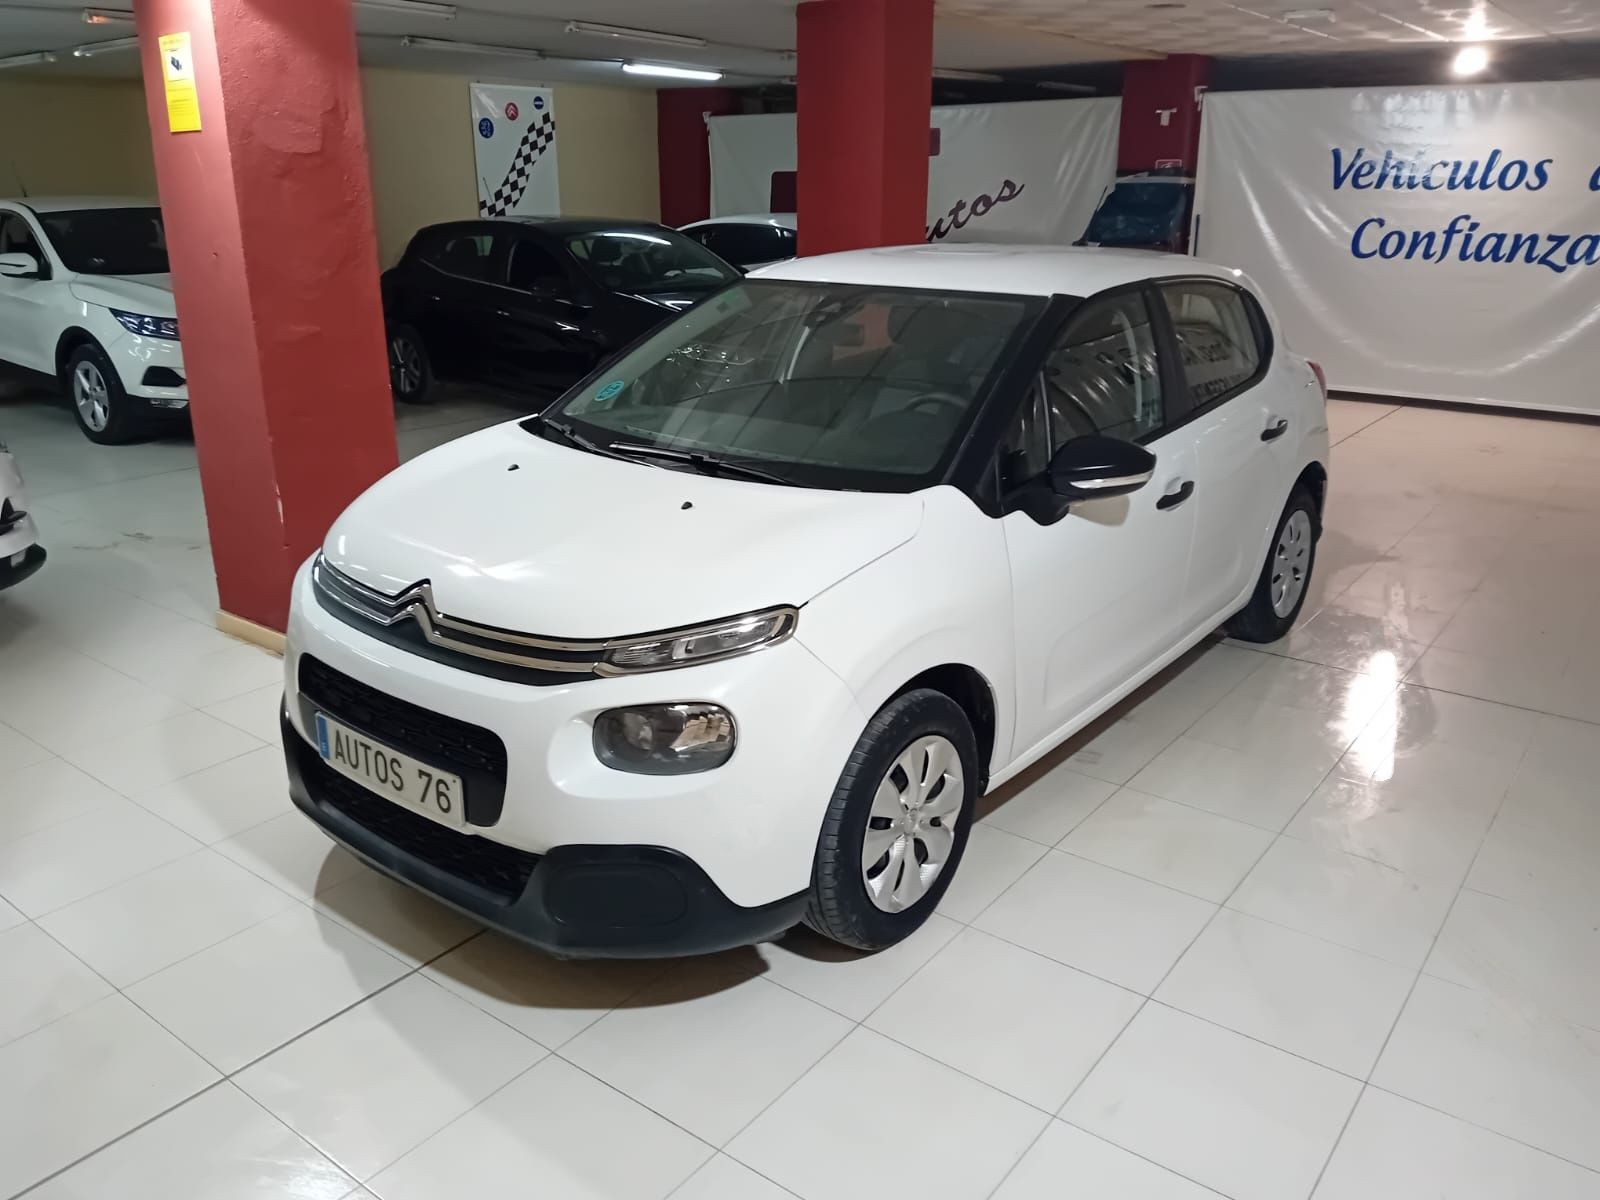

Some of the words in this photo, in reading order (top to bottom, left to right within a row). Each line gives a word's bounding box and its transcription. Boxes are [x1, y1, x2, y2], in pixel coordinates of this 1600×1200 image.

[1331, 147, 1553, 191] Vehículos
[925, 179, 1025, 242] utos
[1351, 214, 1600, 273] Confianza
[335, 729, 404, 792] AUTOS
[417, 769, 451, 814] 76
